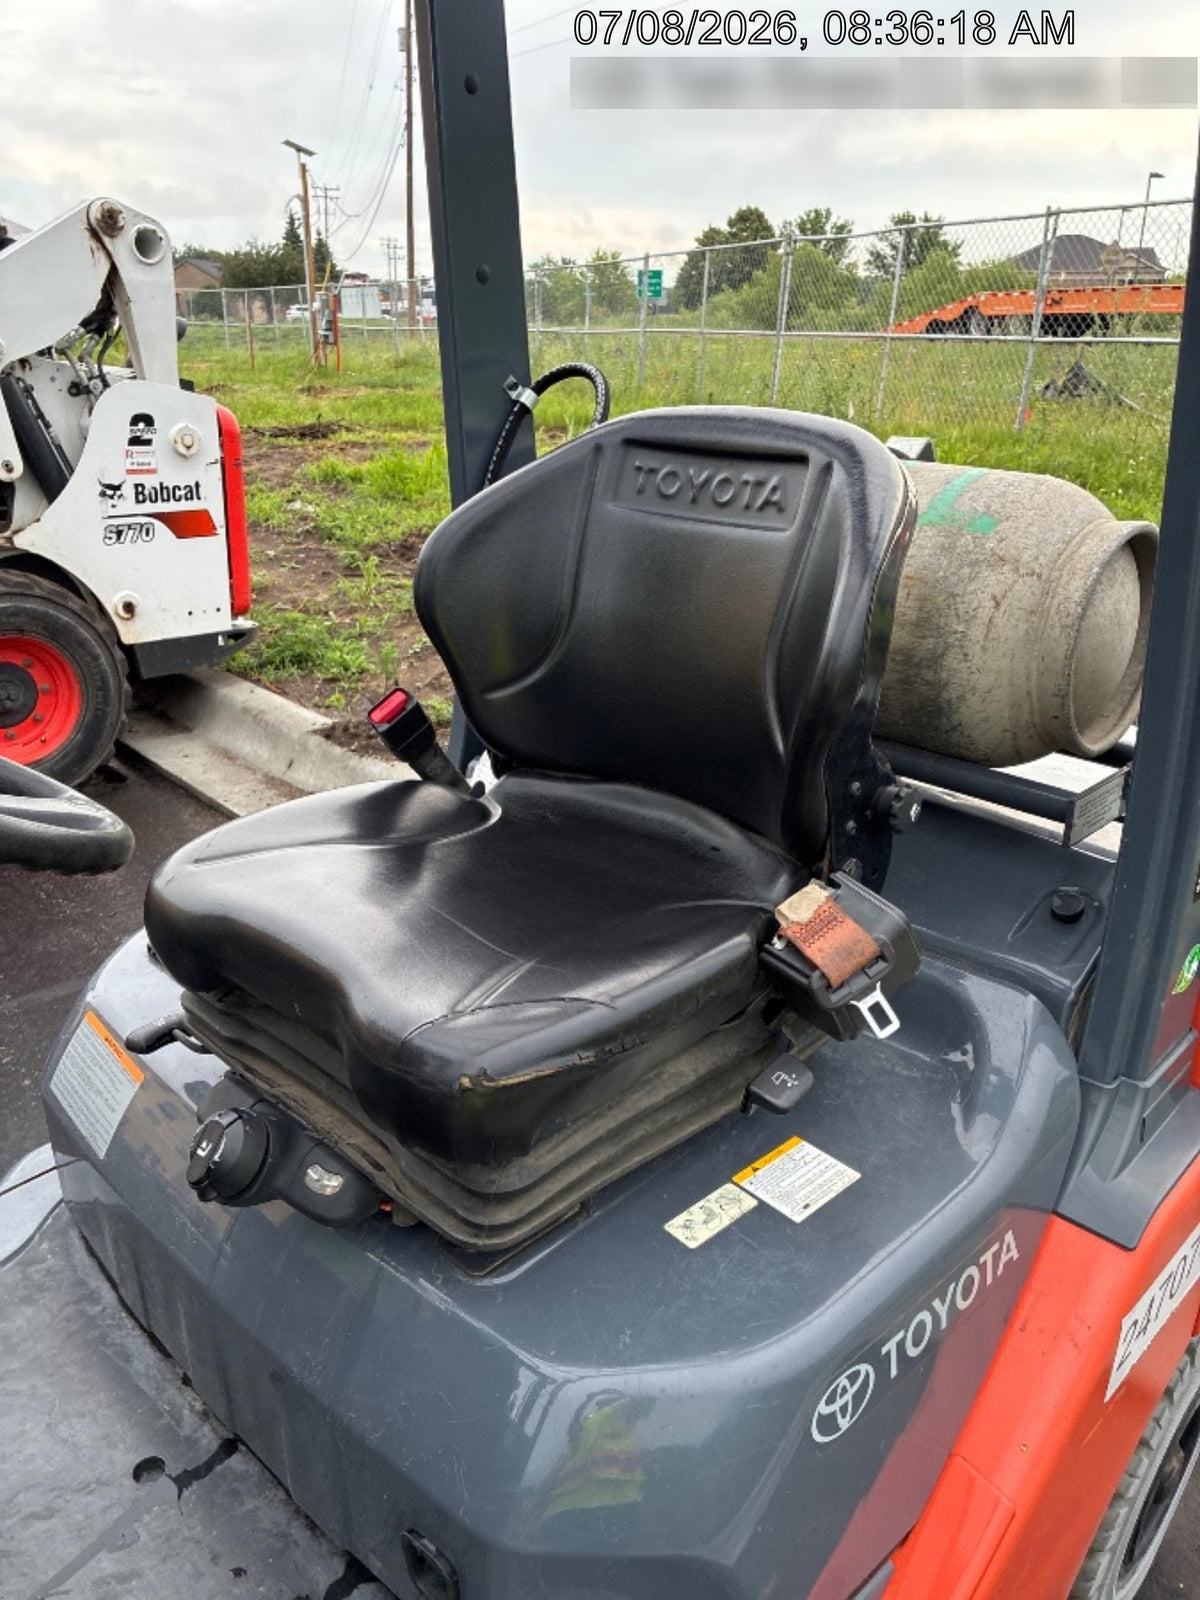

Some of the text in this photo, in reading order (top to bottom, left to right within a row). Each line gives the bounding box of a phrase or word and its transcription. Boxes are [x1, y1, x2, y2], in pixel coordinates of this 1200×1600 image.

[128, 412, 155, 447] 2
[134, 481, 202, 504] Bobcat
[634, 460, 786, 514] TOYOTA
[103, 522, 155, 546] S770
[881, 1229, 1020, 1380] TOYOTA
